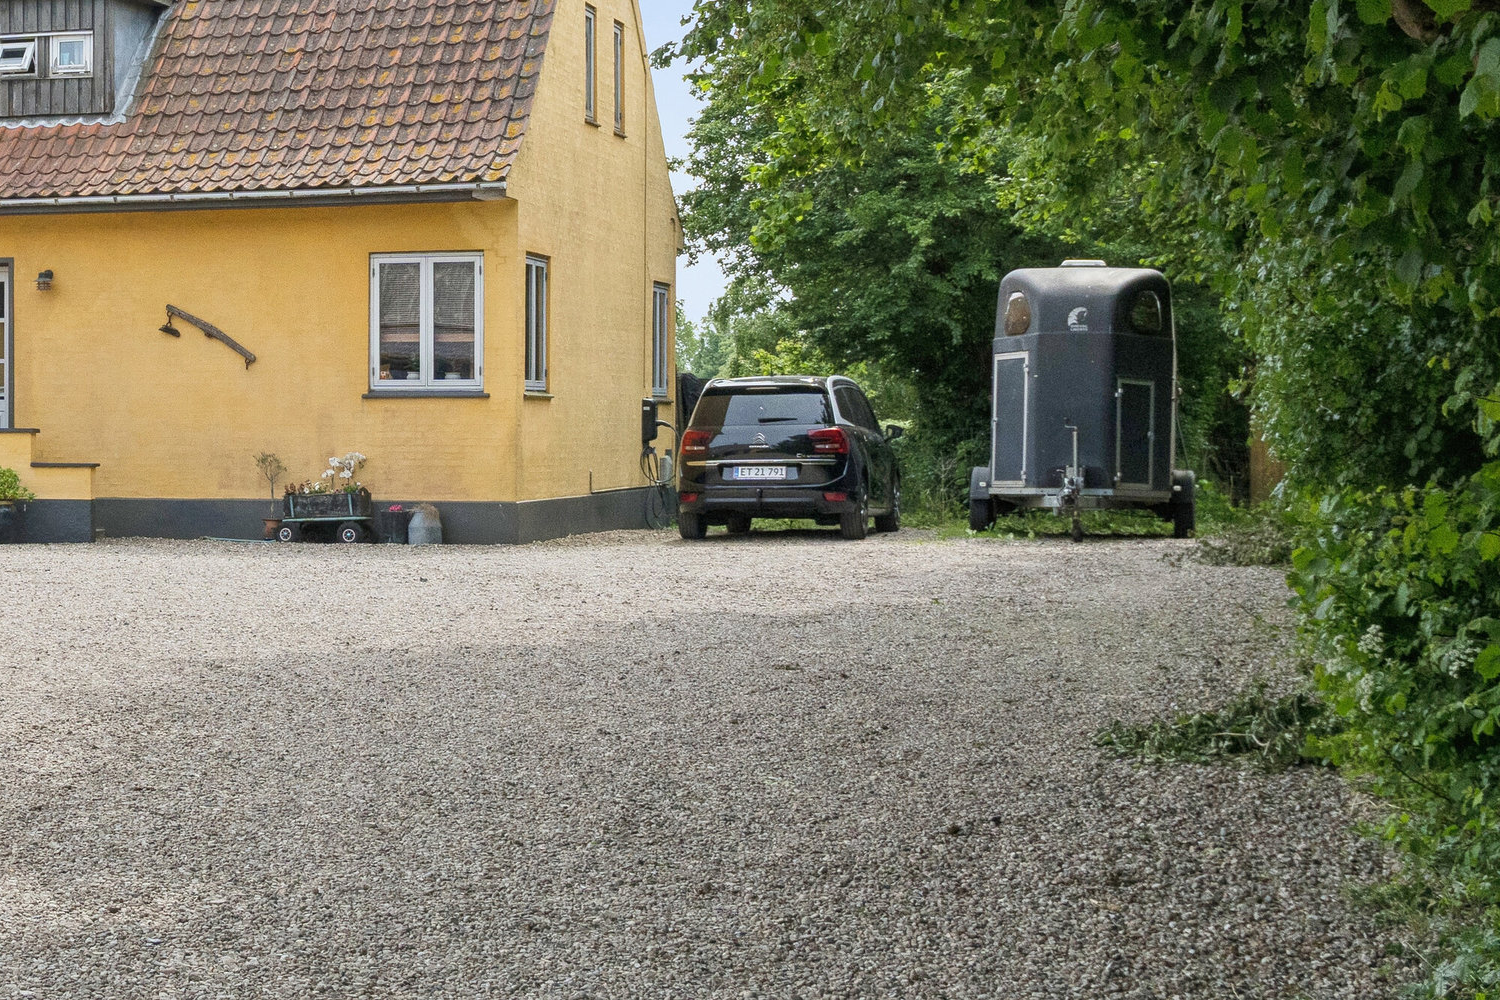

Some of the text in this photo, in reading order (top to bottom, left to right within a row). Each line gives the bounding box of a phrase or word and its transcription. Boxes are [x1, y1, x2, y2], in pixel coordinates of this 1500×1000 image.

[740, 467, 784, 476] ET 21 791
